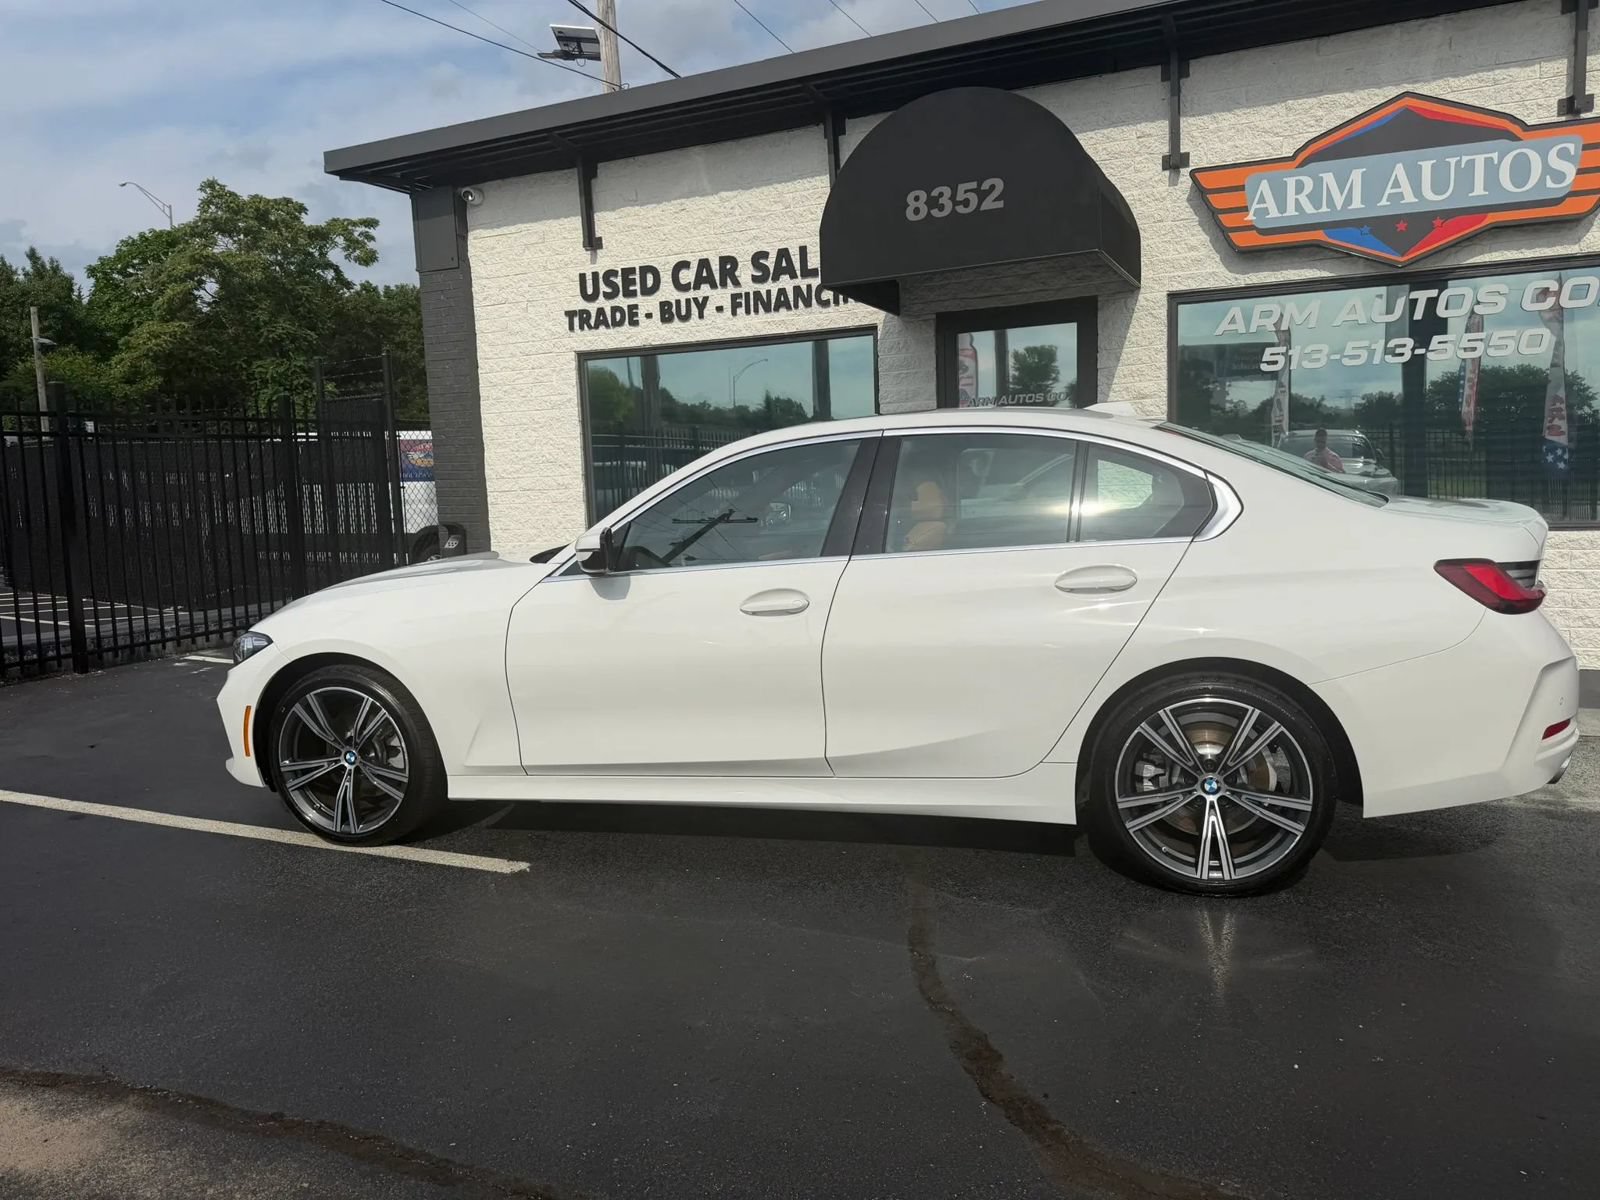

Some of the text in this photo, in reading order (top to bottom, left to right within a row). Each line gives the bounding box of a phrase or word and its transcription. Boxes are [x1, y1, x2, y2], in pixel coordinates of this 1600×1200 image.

[906, 177, 1004, 221] 8352
[1244, 143, 1576, 221] ARM AUTOS
[578, 245, 819, 301] USED CAR SAL
[565, 304, 640, 332] TRADE
[660, 296, 709, 323] BUY
[730, 283, 849, 317] FINANCI
[1214, 299, 1320, 336] ARM
[1331, 283, 1509, 328] AUTOS
[1259, 328, 1551, 372] 513-513-5550
[998, 391, 1044, 405] AUTOS
